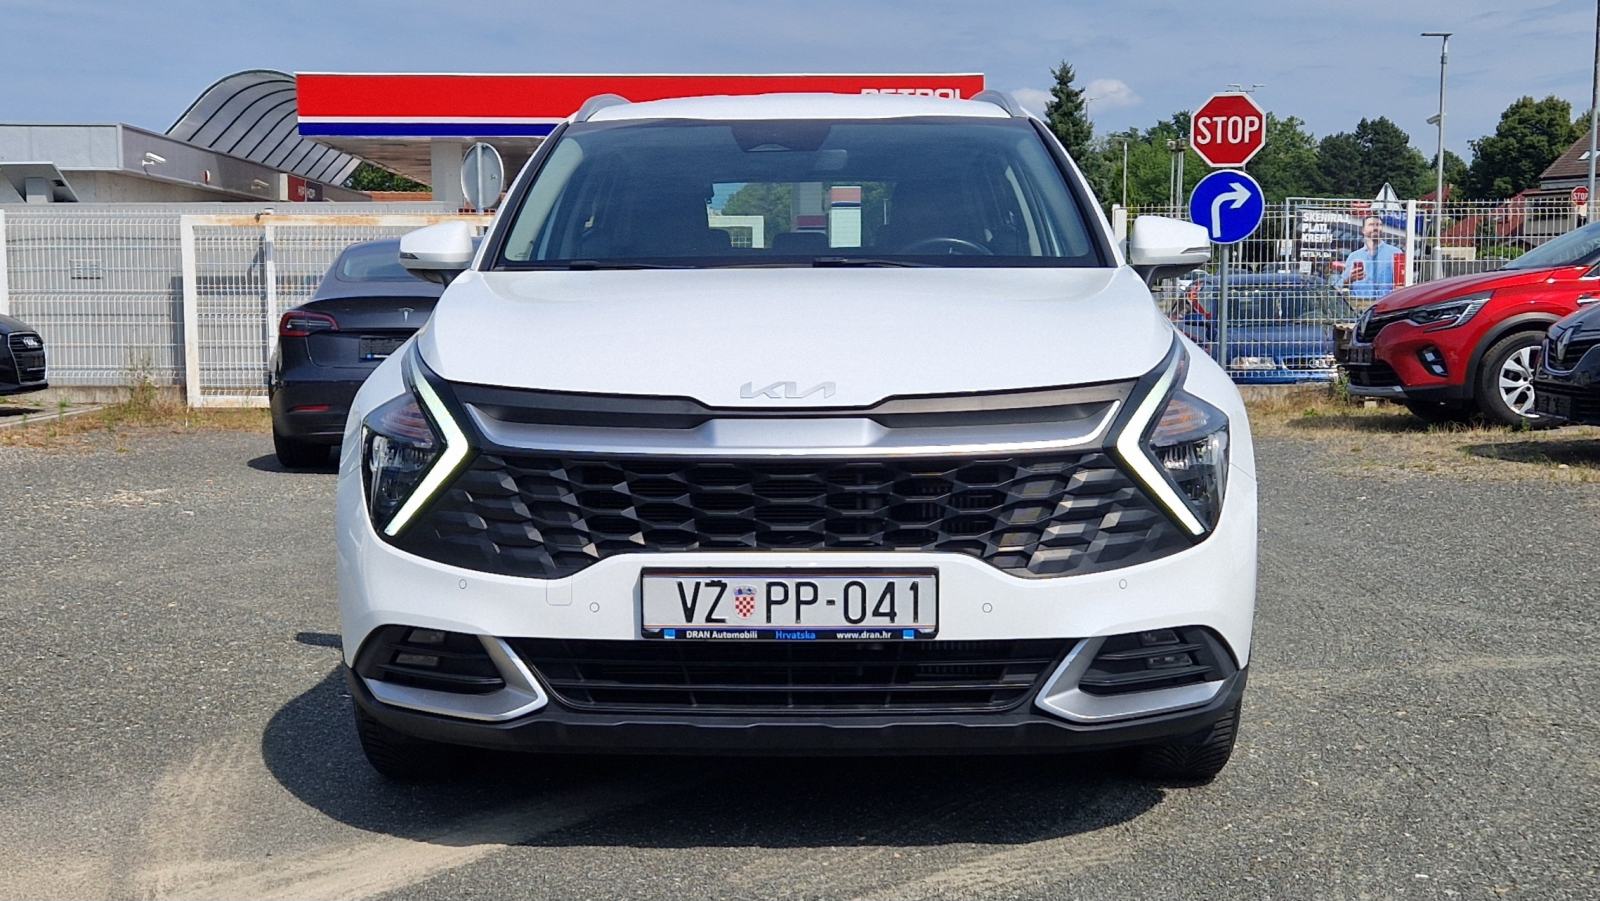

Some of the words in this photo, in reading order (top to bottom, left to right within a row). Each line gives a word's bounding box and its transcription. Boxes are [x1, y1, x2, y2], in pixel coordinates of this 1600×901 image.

[1197, 116, 1260, 145] STOP
[677, 580, 728, 623] VŽ
[765, 581, 920, 624] PP-041
[686, 630, 710, 639] DRAN
[712, 630, 758, 639] Automobili
[775, 630, 816, 640] Hrvatska
[836, 630, 892, 640] www.dran.hr
